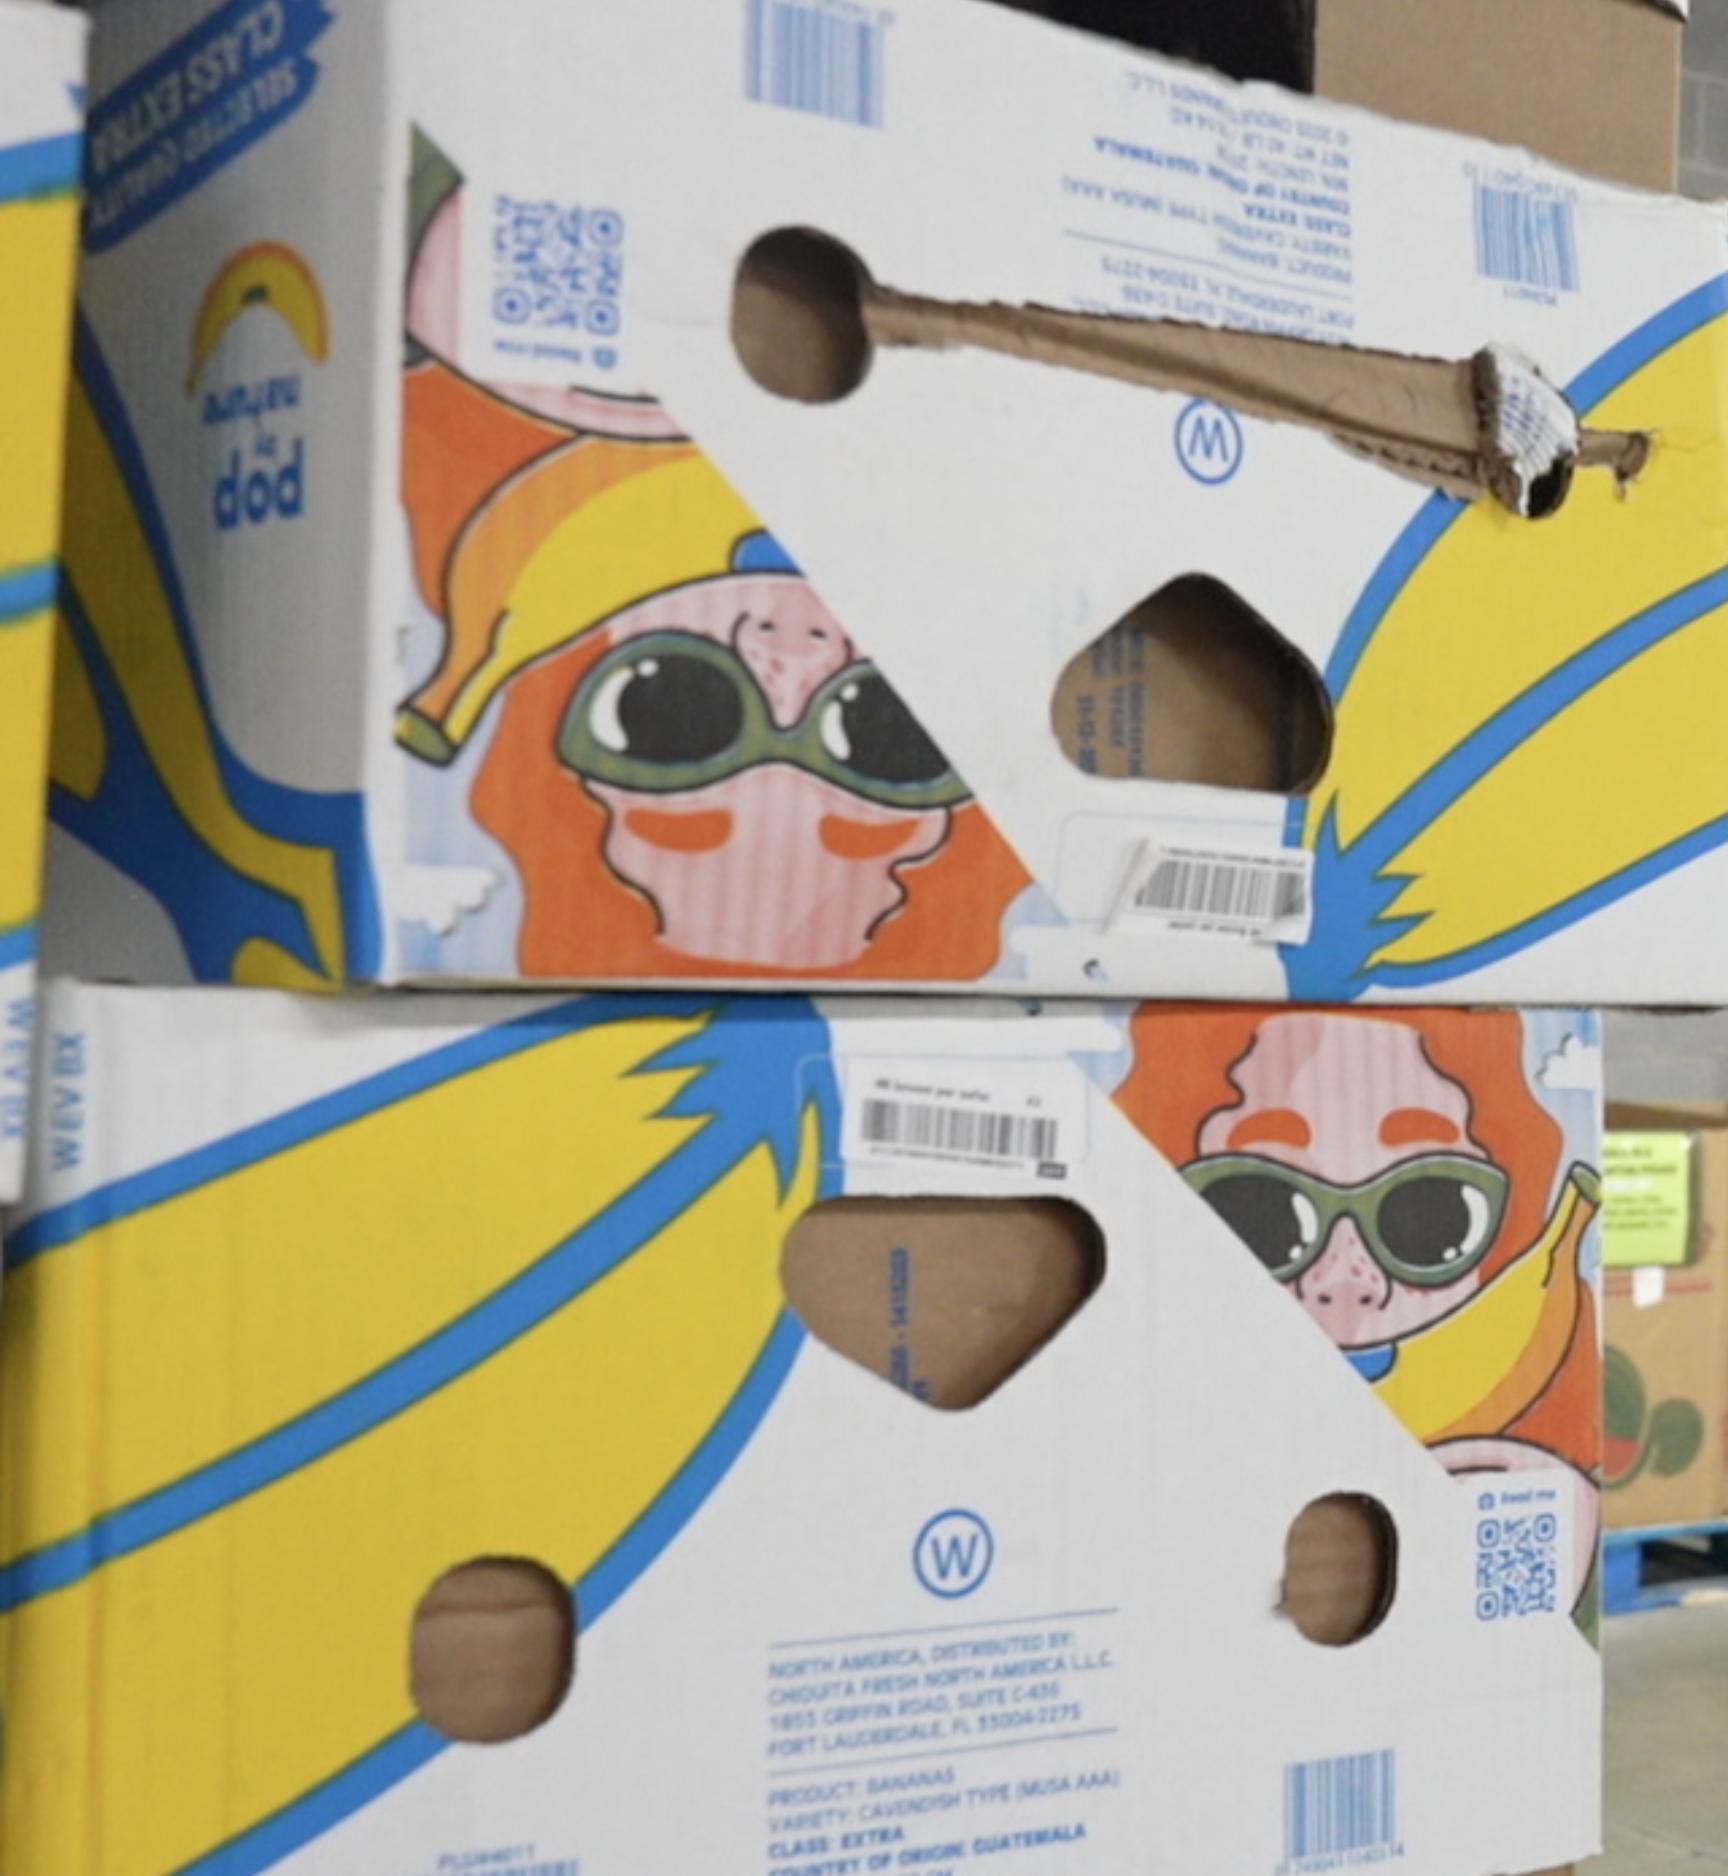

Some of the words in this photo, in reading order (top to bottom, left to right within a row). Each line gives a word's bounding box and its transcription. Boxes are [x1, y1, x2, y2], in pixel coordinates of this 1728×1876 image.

[1093, 135, 1202, 176] GUATEMALA
[1254, 183, 1277, 199] OF
[1279, 188, 1351, 215] COUNTRY
[1242, 202, 1298, 227] EXTRA
[214, 437, 304, 530] pop
[931, 1533, 978, 1581] W
[768, 1658, 835, 1681] NORTH
[930, 1633, 1044, 1663] DISTRIBUTED
[768, 1681, 855, 1709] CHIQUITA
[861, 1673, 921, 1698] FRESH
[924, 1666, 986, 1689] NORTH
[990, 1657, 1068, 1682] AMERICA
[823, 1701, 893, 1727] GRIFFIN
[957, 1687, 1007, 1710] SUITE
[768, 1736, 818, 1757] FORT
[951, 1715, 972, 1734] FL
[858, 1790, 961, 1822] CAVENDISH
[965, 1783, 1011, 1804] TYPE
[1016, 1774, 1072, 1802] (MUSA
[1075, 1768, 1121, 1793] AAA)
[866, 1767, 956, 1795] BANANAS
[769, 1853, 862, 1876] COUNTRY
[867, 1850, 895, 1872] OF
[971, 1821, 1088, 1856] GUATEMALA
[840, 1825, 906, 1851] EXTRA
